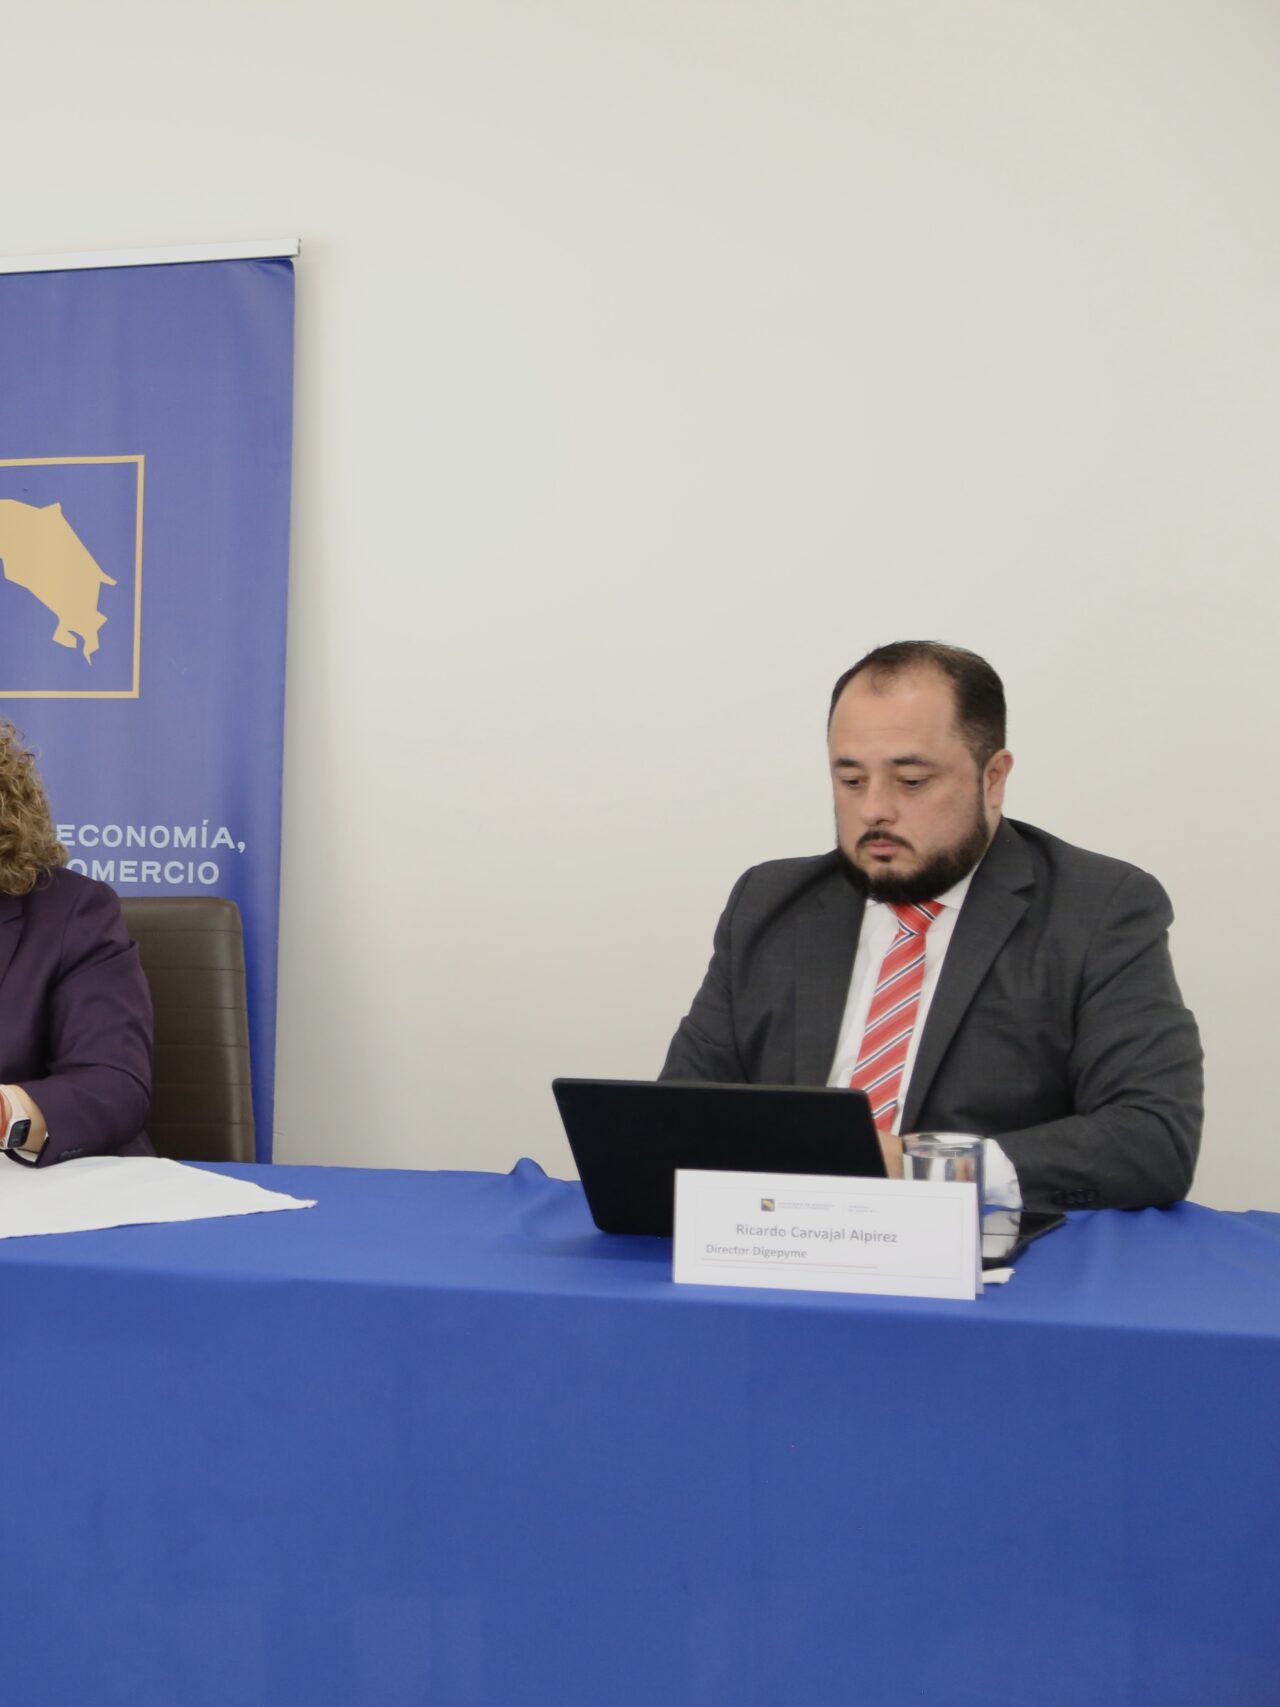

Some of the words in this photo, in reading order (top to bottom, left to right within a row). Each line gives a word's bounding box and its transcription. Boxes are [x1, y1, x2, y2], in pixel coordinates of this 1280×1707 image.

[56, 819, 246, 853] ECONOMÍA,
[65, 859, 220, 885] OMERCIO
[736, 1223, 787, 1238] Ricardo
[791, 1226, 846, 1243] Carvajal
[706, 1244, 749, 1256] Director
[752, 1246, 808, 1260] Digepyme
